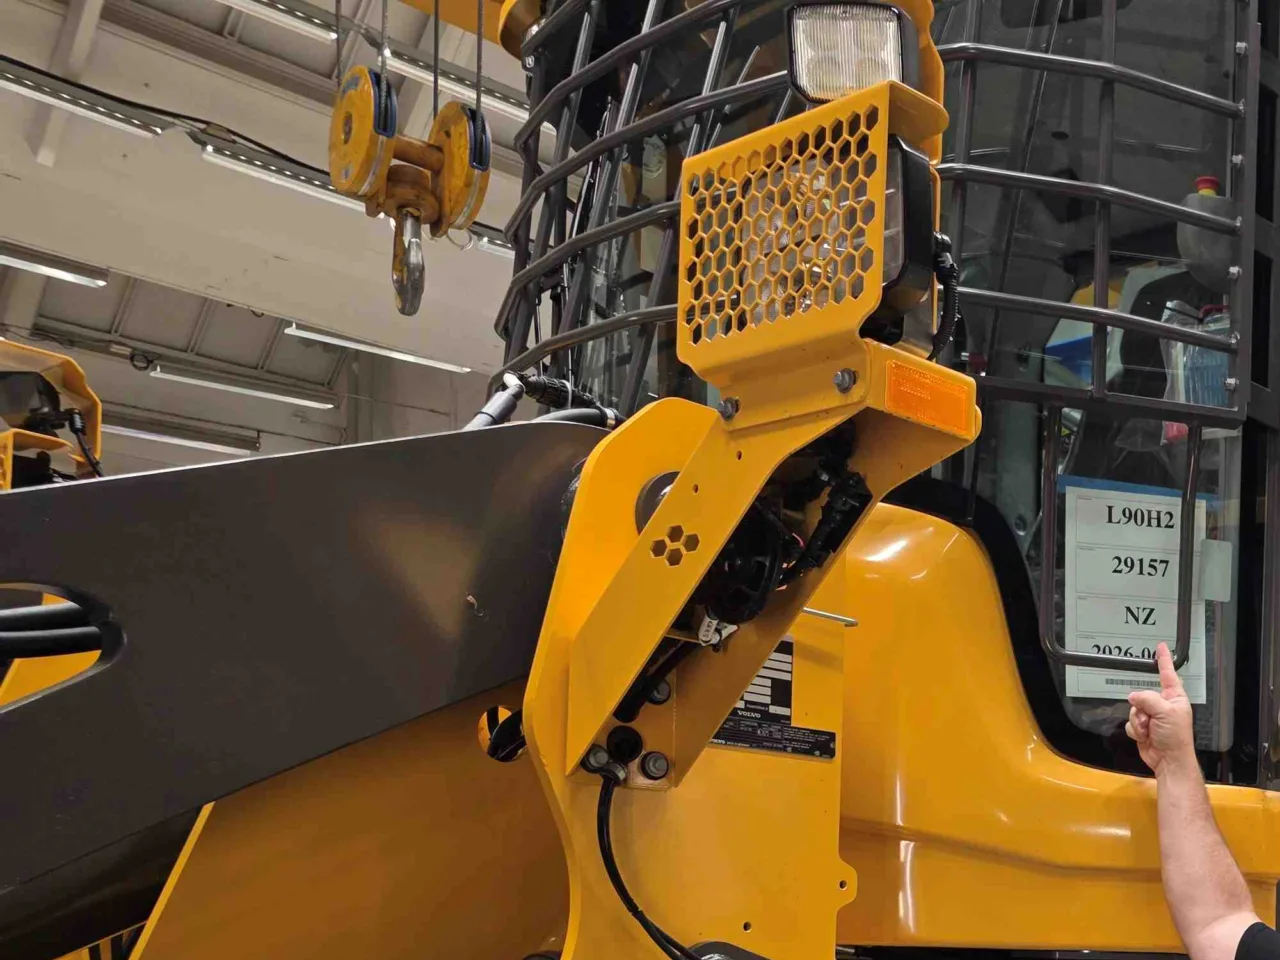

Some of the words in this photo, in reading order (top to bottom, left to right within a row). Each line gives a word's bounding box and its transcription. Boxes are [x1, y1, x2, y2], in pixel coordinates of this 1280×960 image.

[1106, 505, 1175, 529] L90H2
[1111, 556, 1170, 577] 29157
[1124, 606, 1156, 626] NZ
[737, 710, 761, 719] VOLVO
